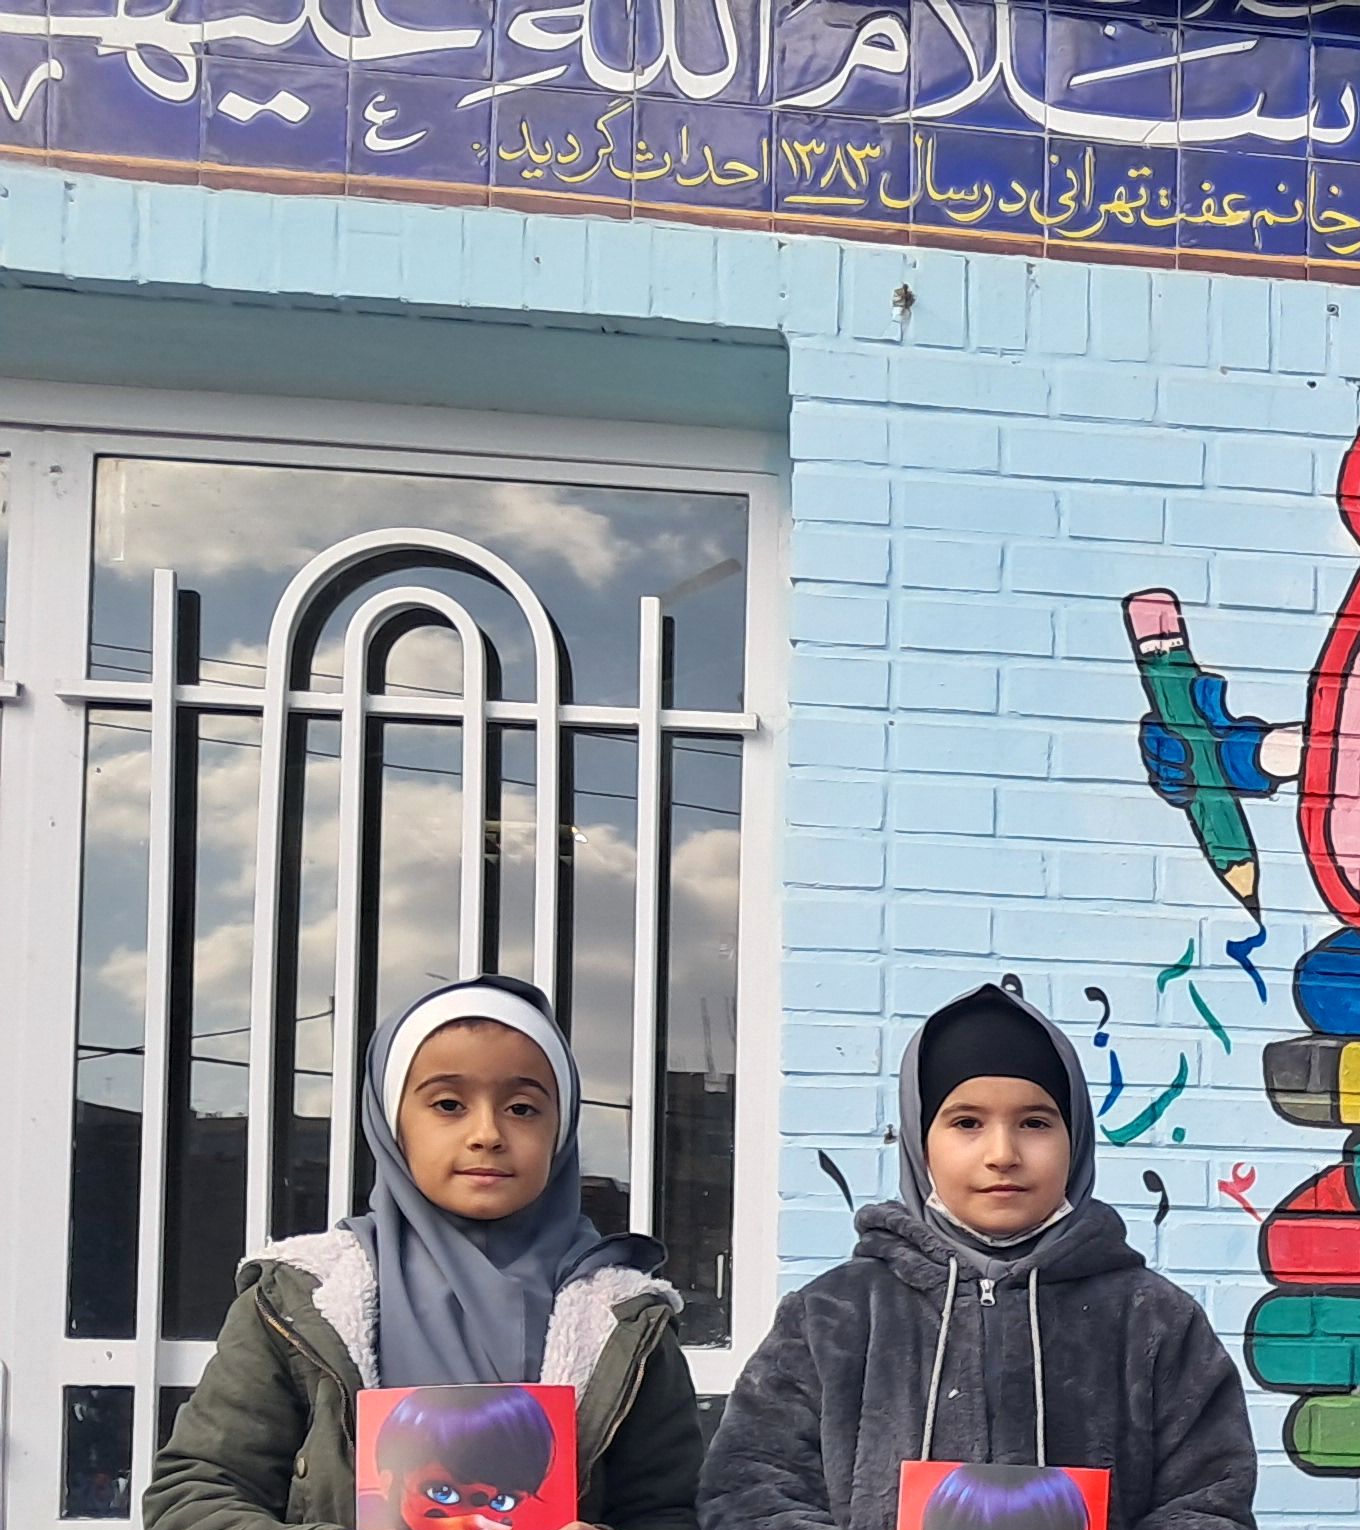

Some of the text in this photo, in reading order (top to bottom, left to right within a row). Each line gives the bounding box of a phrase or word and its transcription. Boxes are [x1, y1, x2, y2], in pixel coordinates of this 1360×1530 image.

[772, 0, 1358, 143] سلام
[609, 126, 770, 188] احداث
[780, 136, 882, 194] ۱۳۸۳
[878, 133, 980, 210] سال
[947, 178, 1027, 222] در
[1029, 147, 1148, 238] تهرانی
[1140, 181, 1251, 228] عفت
